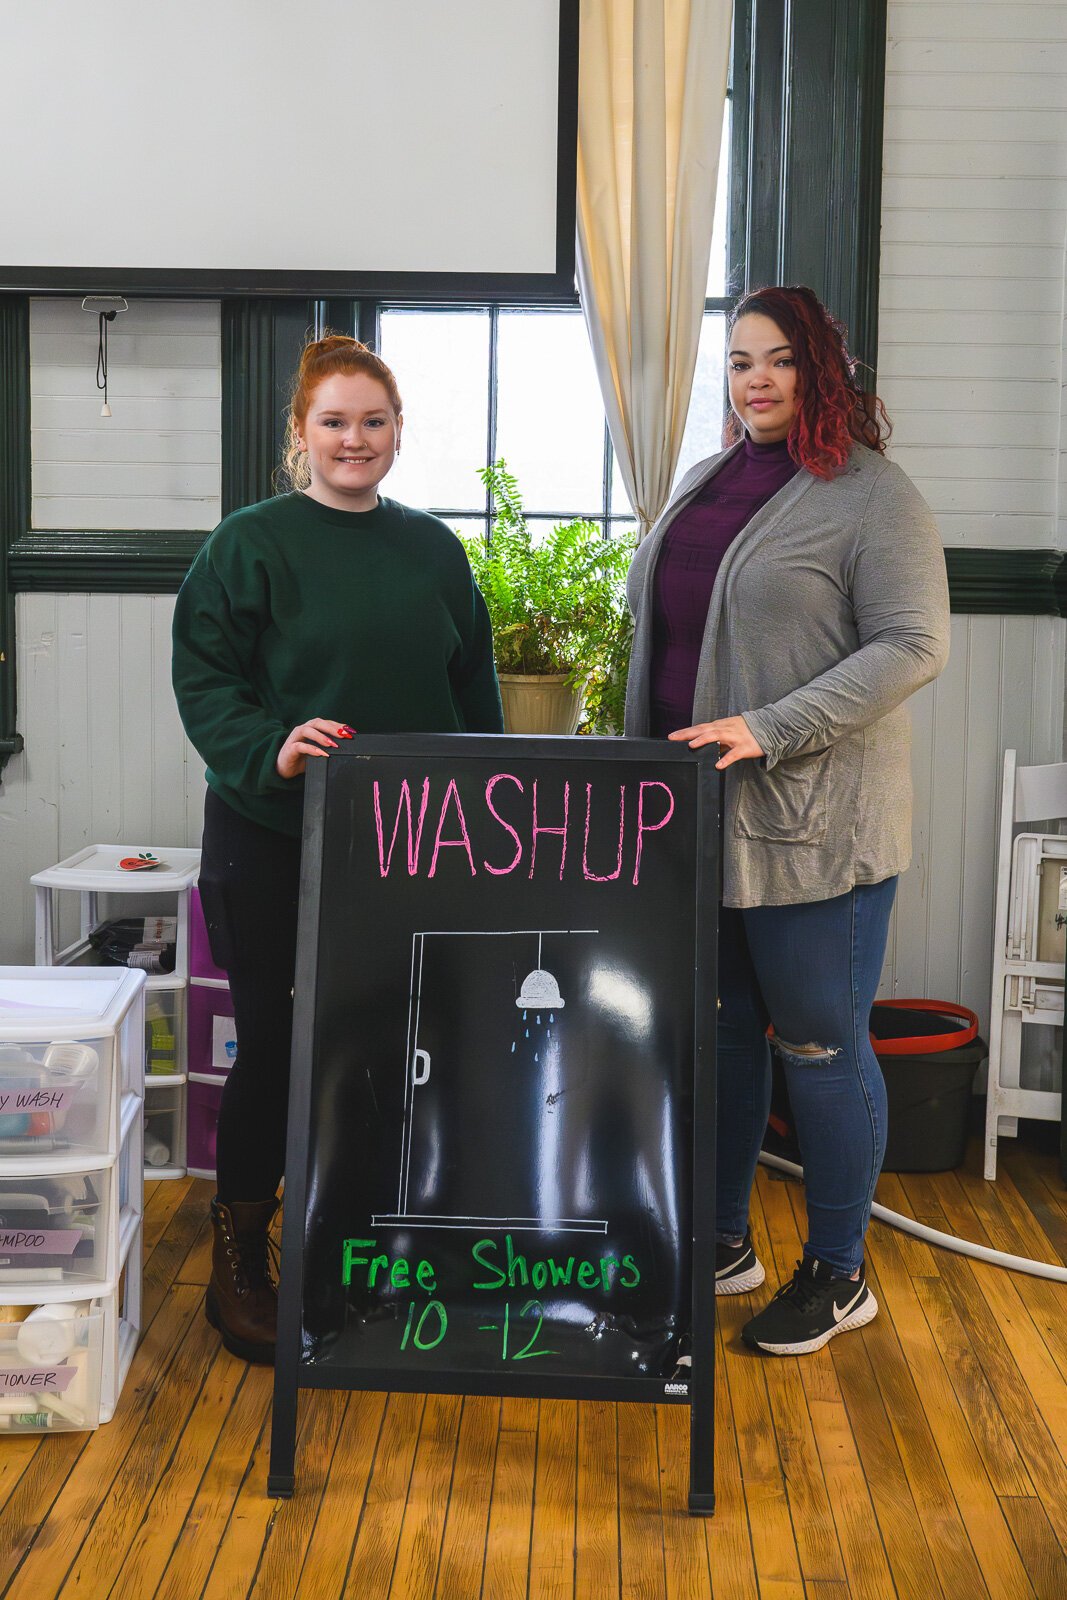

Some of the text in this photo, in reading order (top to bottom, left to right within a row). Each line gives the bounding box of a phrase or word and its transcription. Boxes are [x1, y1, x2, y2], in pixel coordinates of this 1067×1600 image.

[373, 773, 675, 886] WASHUP
[16, 1091, 64, 1108] WASH
[342, 1234, 641, 1291] Free Showers
[400, 1300, 448, 1350] 10
